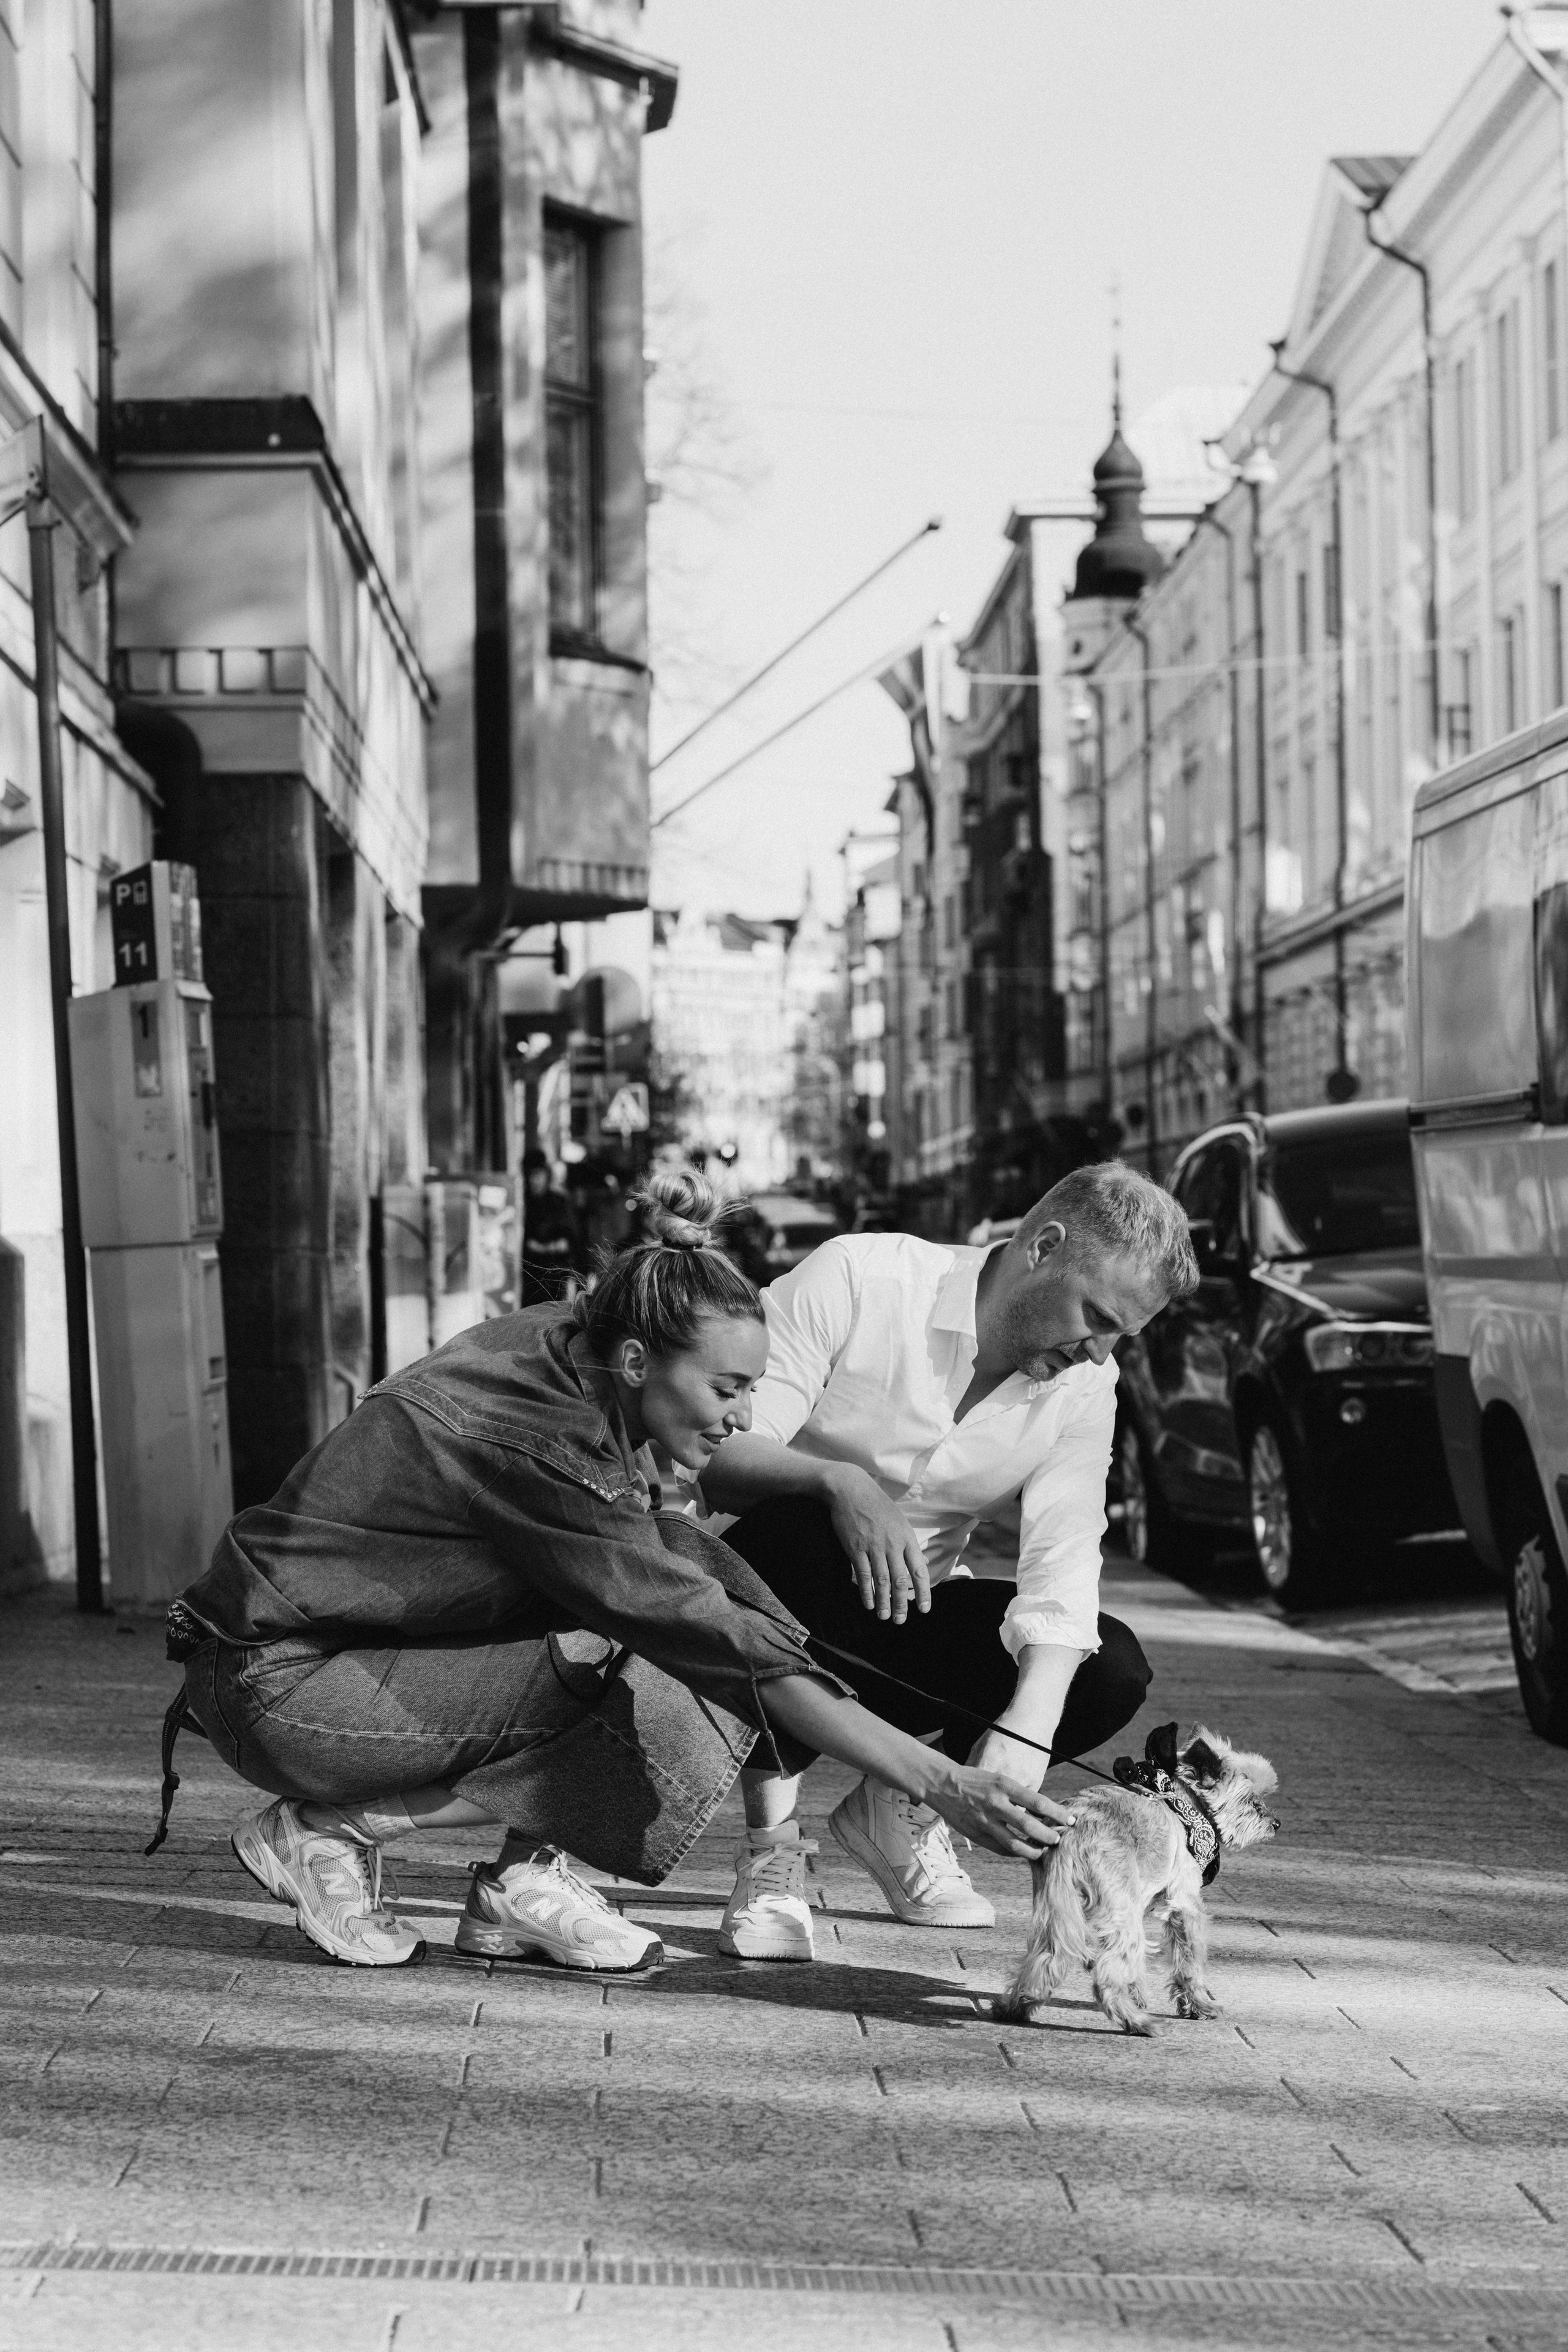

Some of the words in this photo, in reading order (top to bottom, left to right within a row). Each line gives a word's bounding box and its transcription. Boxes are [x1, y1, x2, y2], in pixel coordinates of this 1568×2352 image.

[119, 941, 147, 967] 11
[318, 1872, 353, 1896] N
[527, 1894, 562, 1921] N
